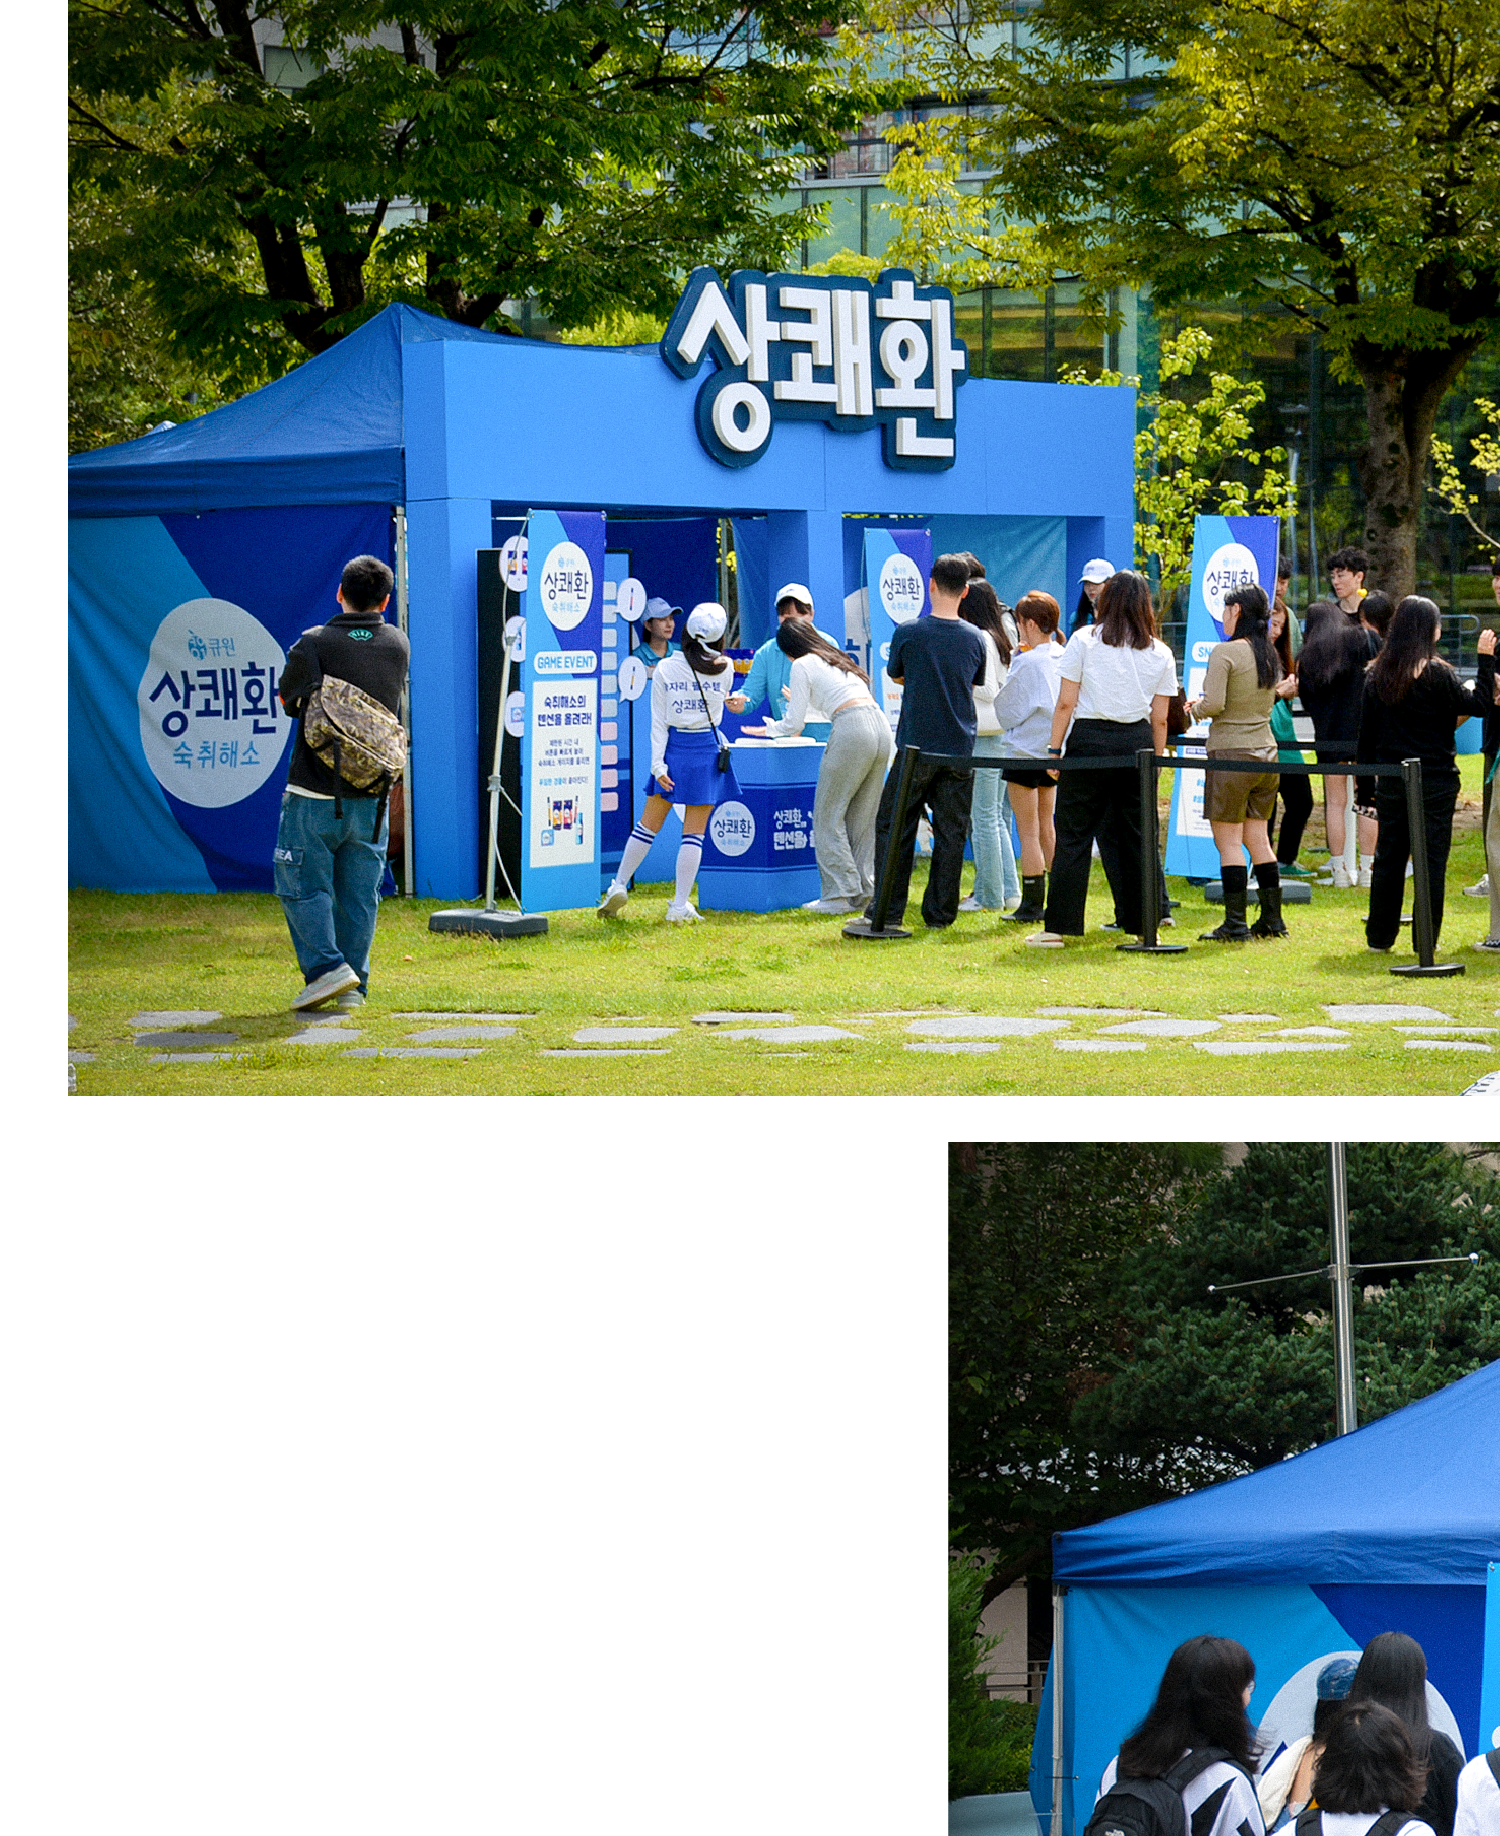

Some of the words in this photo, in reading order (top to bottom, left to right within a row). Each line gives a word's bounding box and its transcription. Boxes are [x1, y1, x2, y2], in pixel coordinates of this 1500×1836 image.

[676, 280, 966, 458] 상쾌환
[544, 570, 589, 600] 상쾌환
[882, 576, 920, 601] 상쾌환
[208, 637, 236, 657] 큐원
[1198, 646, 1212, 657] SN
[537, 657, 563, 669] GAME
[564, 655, 594, 668] EVENT
[149, 661, 280, 738] 상쾌환
[672, 699, 709, 714] 상쾌환
[173, 741, 260, 769] 숙취해소
[714, 818, 752, 838] 상쾌환
